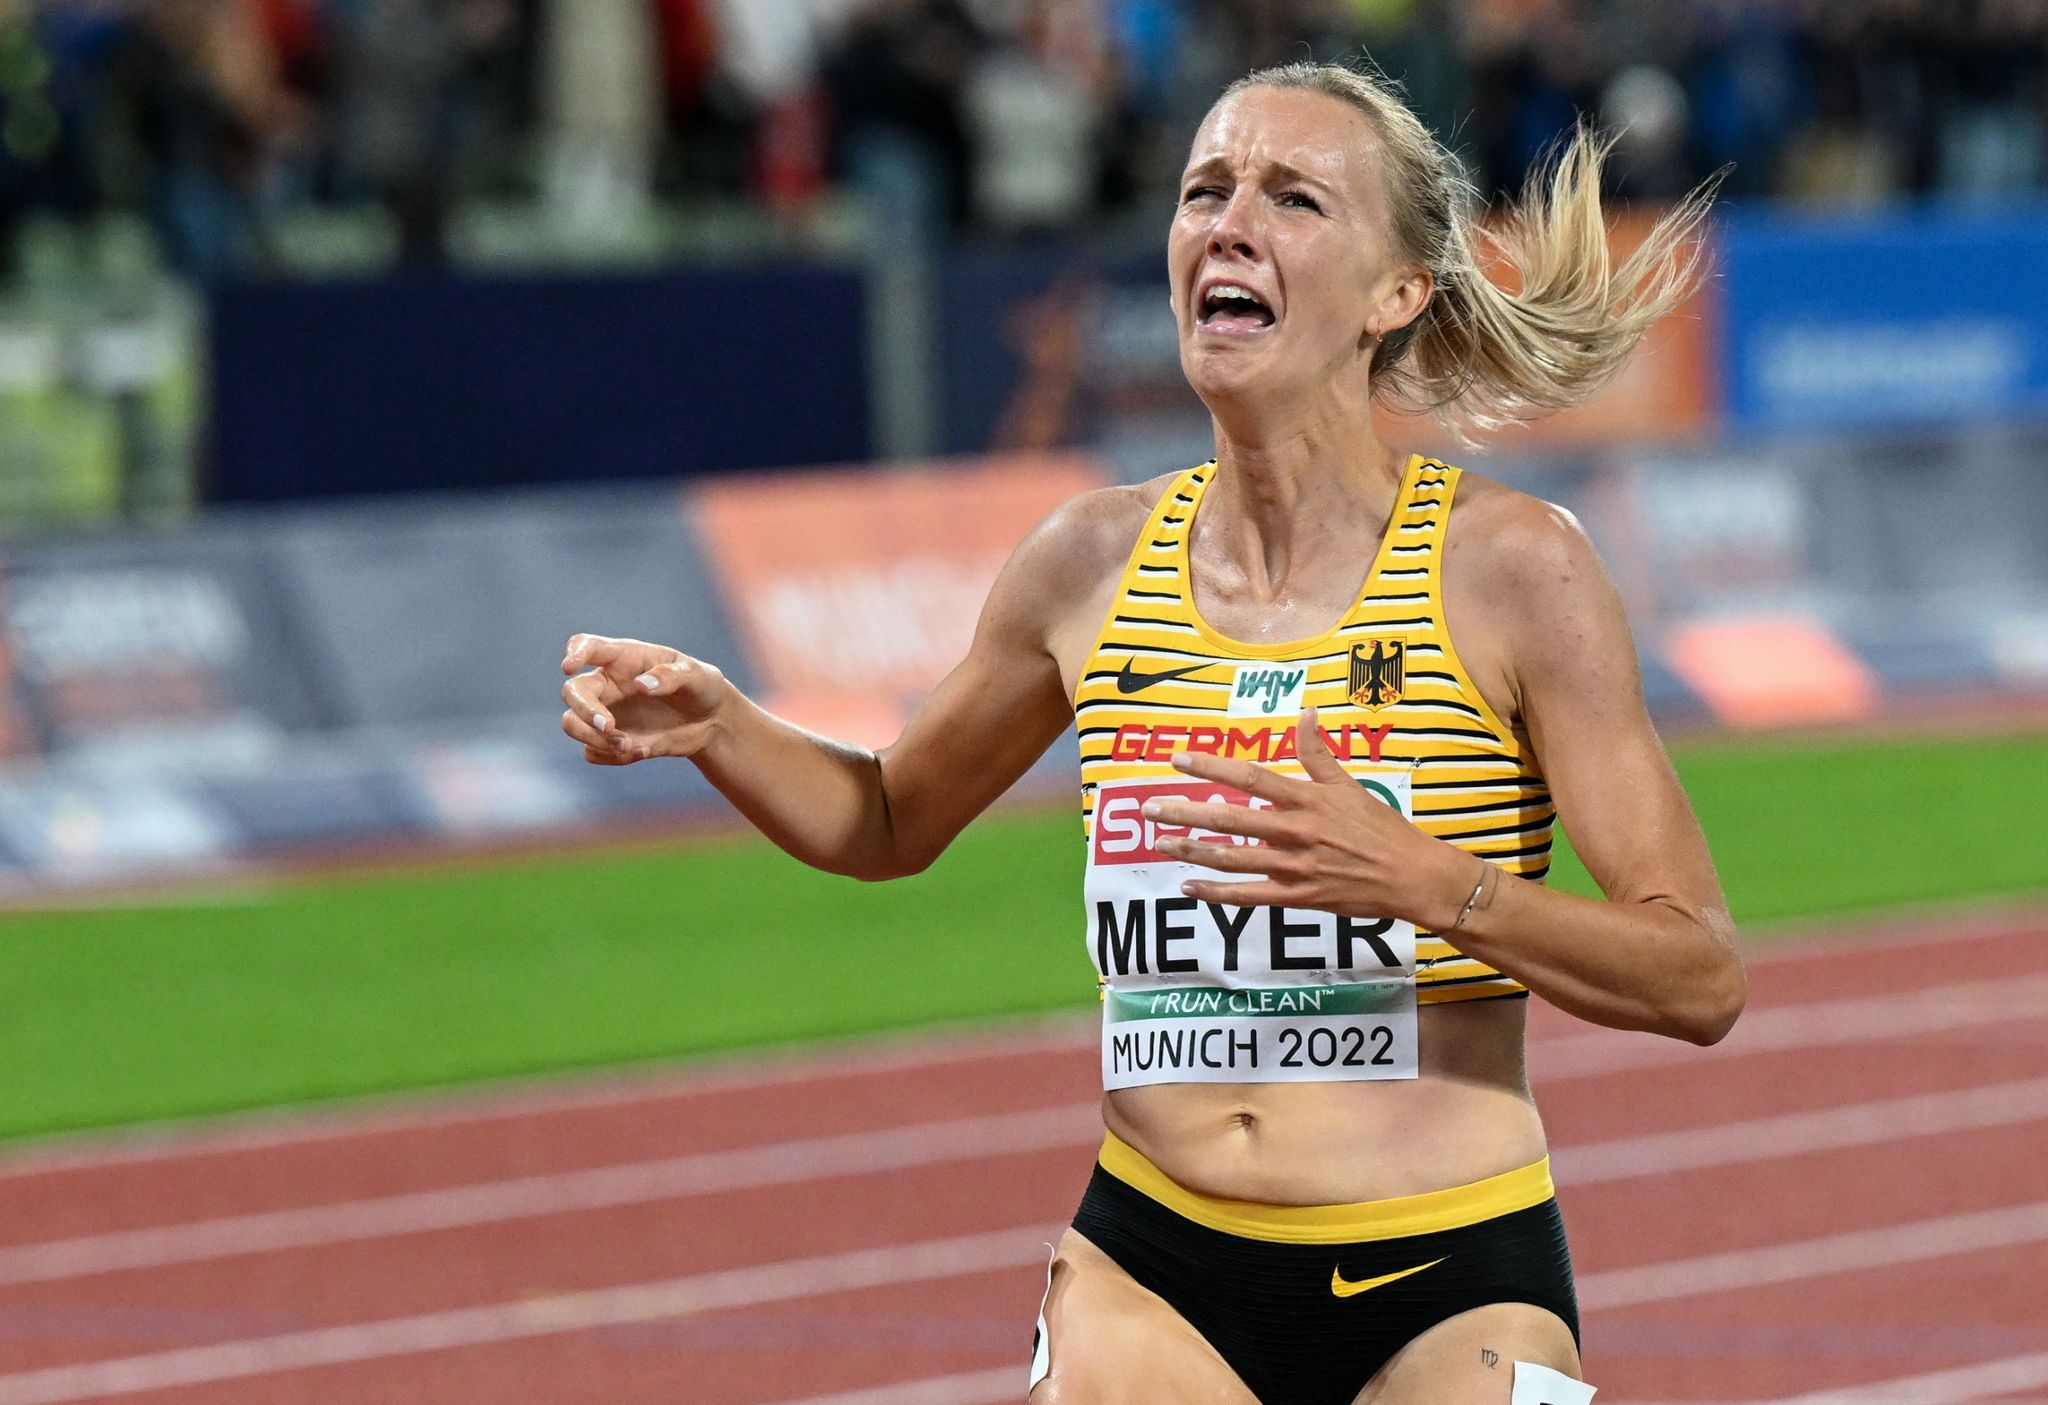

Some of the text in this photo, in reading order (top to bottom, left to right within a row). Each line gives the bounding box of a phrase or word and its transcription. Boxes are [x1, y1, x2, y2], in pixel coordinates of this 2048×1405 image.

[1111, 724, 1394, 762] GERMANY
[1097, 897, 1403, 976] MEYER
[1165, 992, 1222, 1014] RUN
[1113, 1026, 1395, 1074] MUNICH 2022
